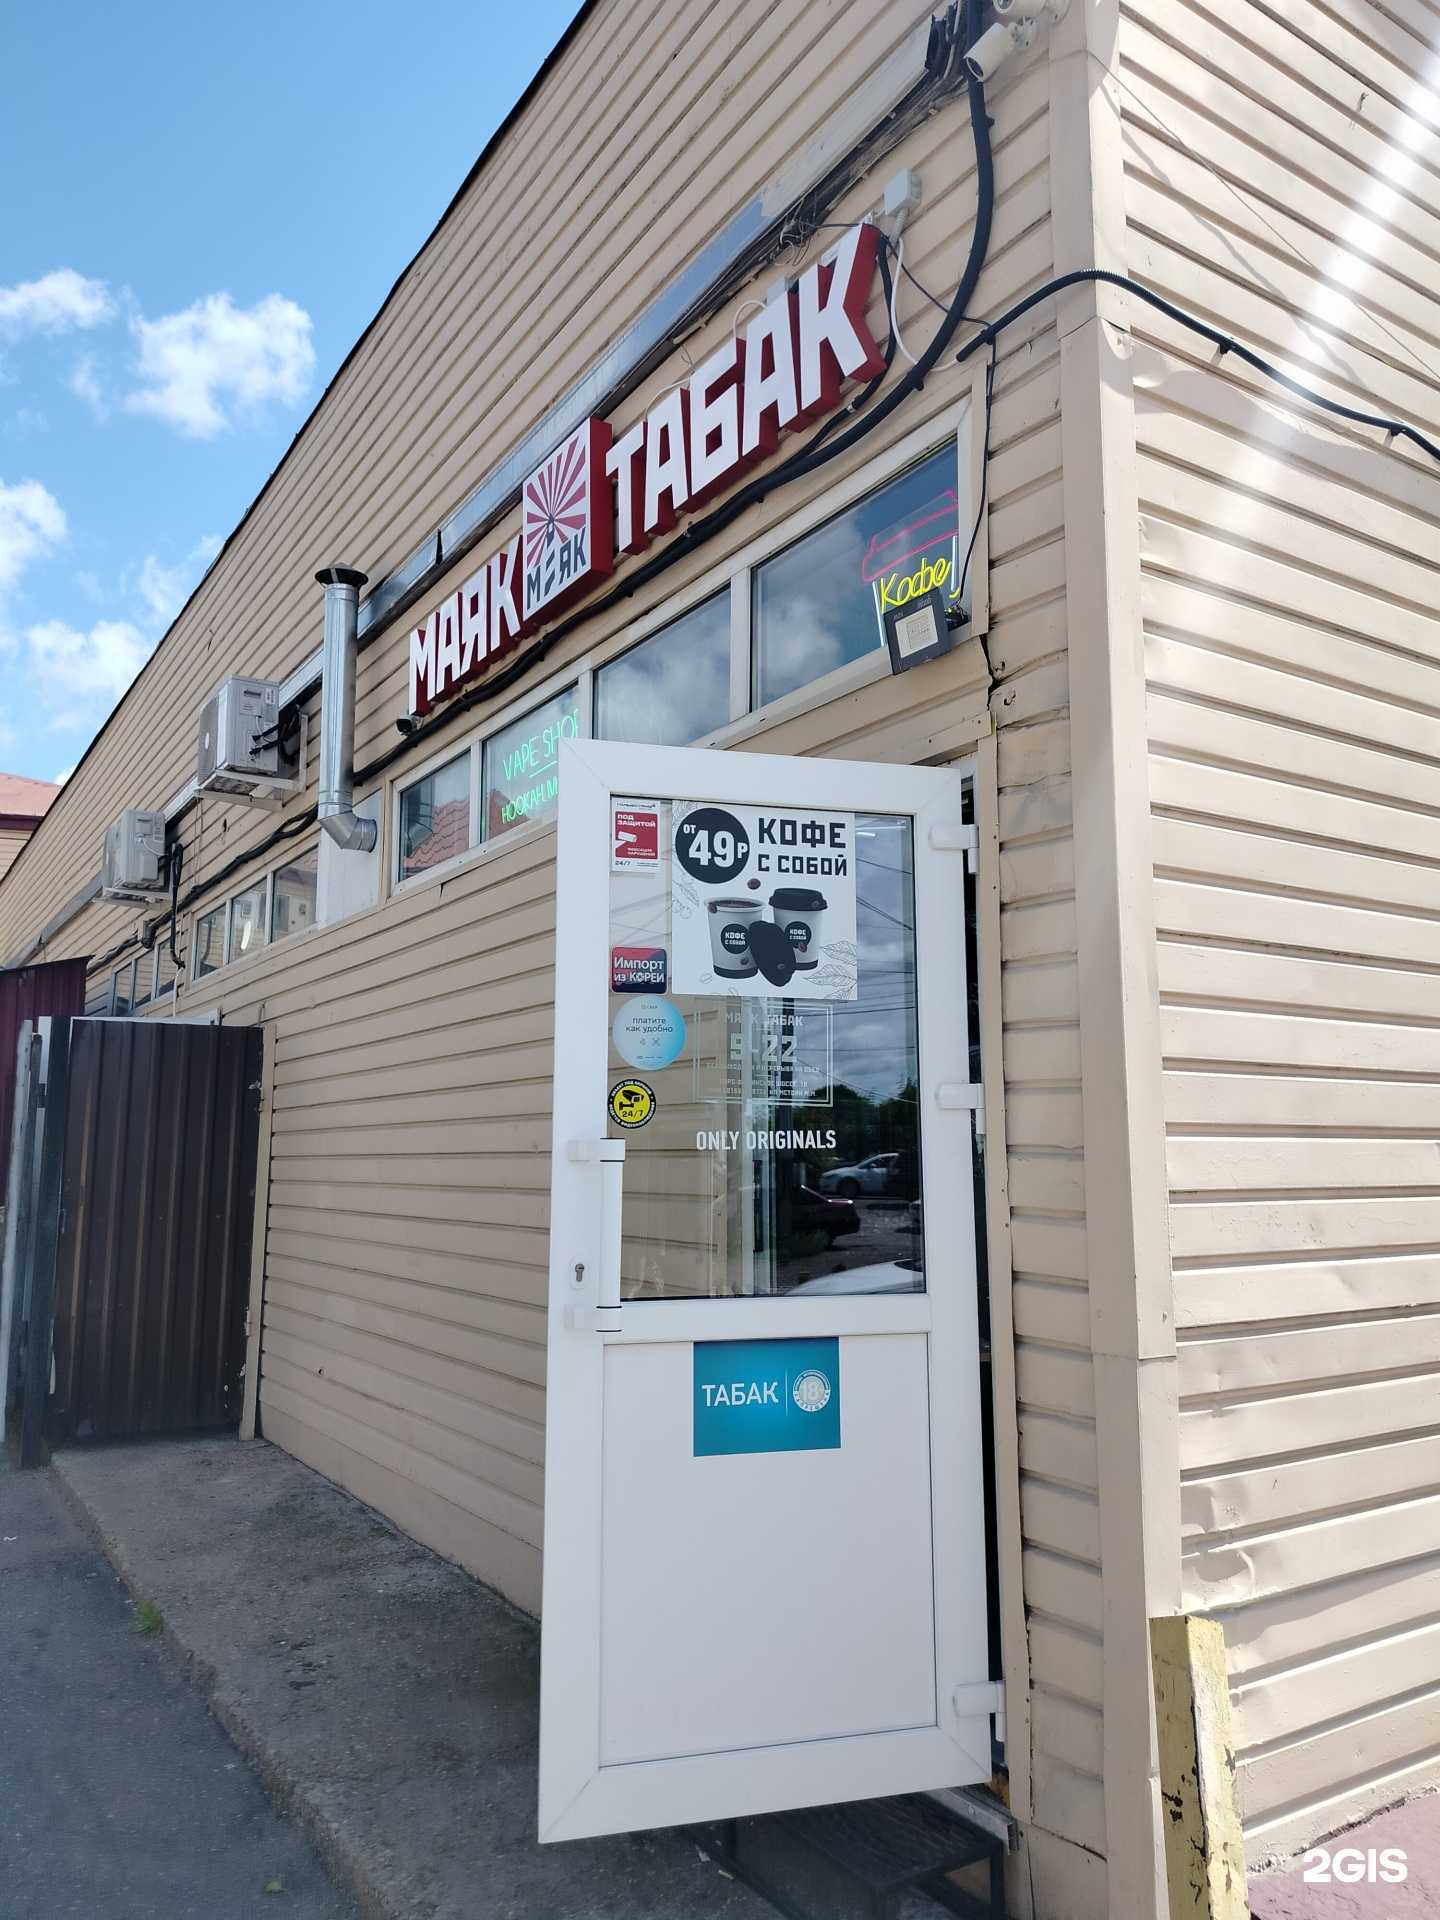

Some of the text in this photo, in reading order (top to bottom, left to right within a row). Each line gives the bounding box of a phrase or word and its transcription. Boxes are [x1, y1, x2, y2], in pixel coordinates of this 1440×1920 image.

[408, 223, 872, 716] МАЯК ТАБАК
[503, 735, 540, 781] VAPE
[683, 823, 696, 835] ОТ
[758, 817, 847, 849] КОФЕ
[758, 853, 848, 877] С СОБОЙ
[725, 931, 746, 940] КОФЕ
[614, 957, 665, 972] Импорт
[614, 972, 665, 983] из КОРЕИ
[632, 1017, 667, 1025] платите
[725, 1013, 760, 1025] МАК
[625, 1024, 674, 1034] как удобно
[622, 1109, 644, 1119] 24/7
[696, 1130, 837, 1151] ONLY ORIGINALS
[701, 1381, 779, 1407] ТАБАК
